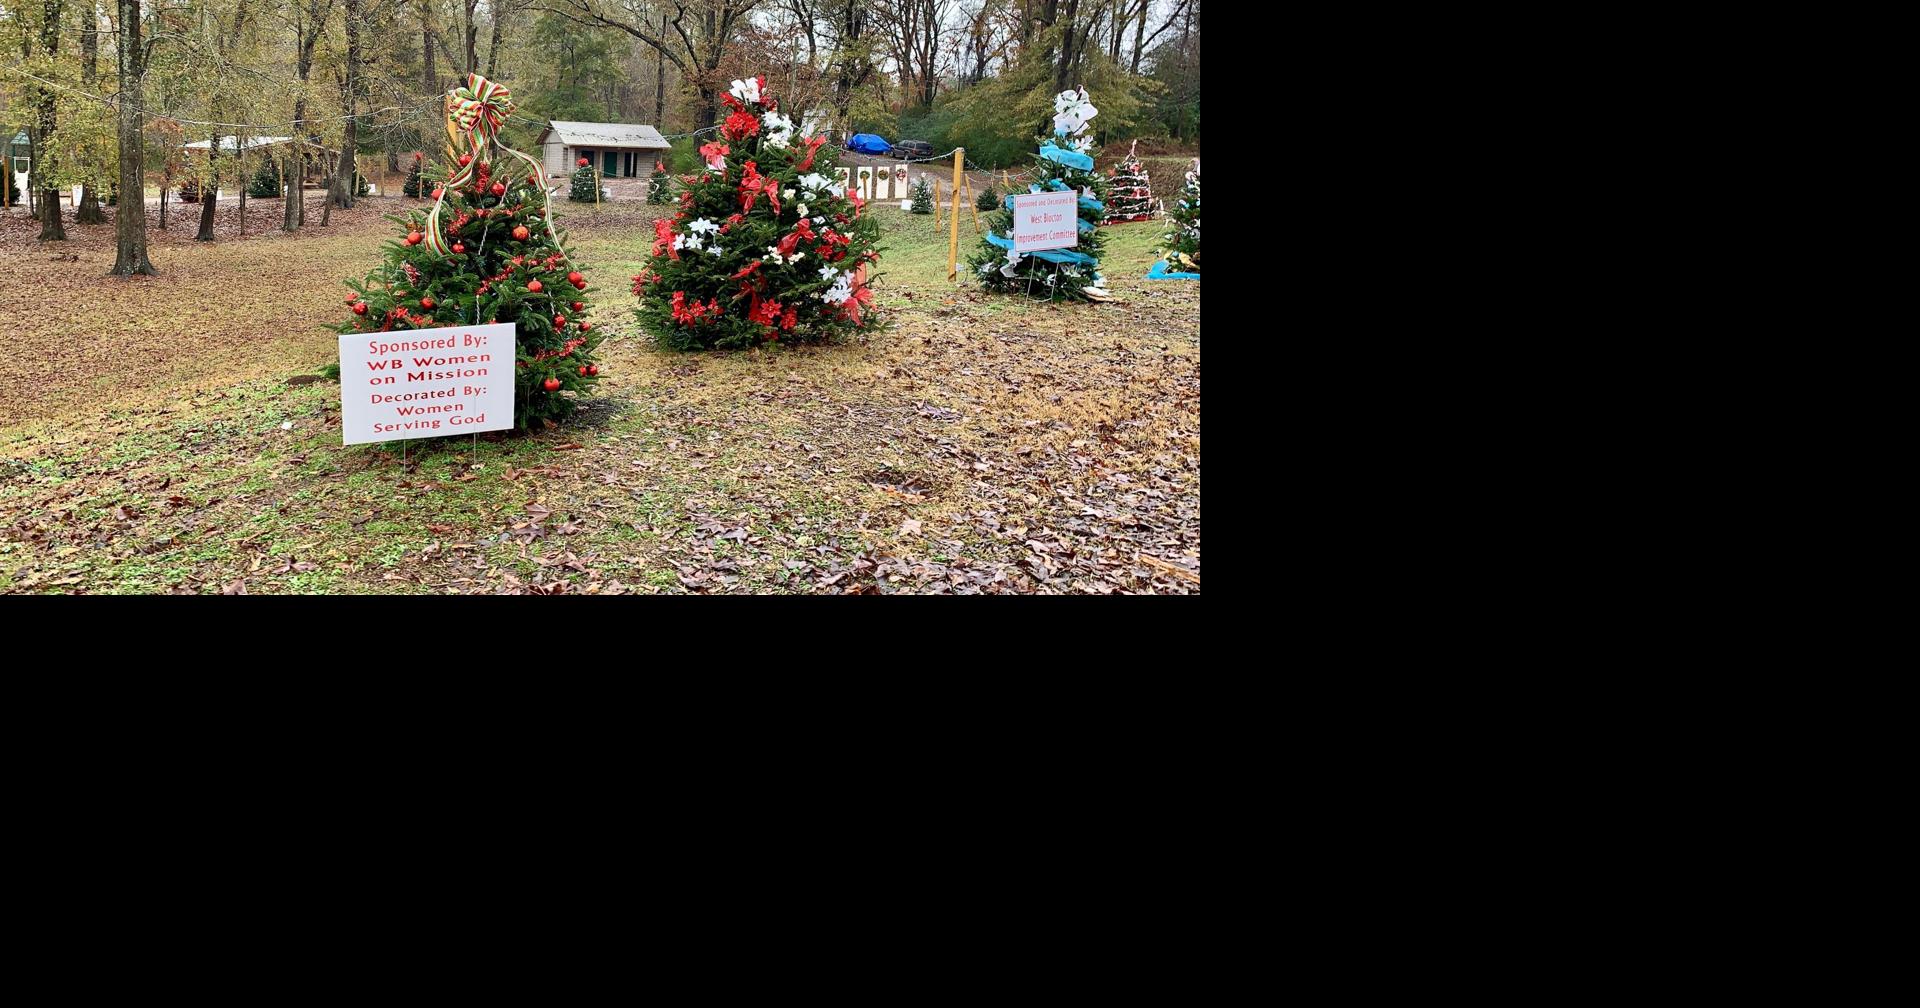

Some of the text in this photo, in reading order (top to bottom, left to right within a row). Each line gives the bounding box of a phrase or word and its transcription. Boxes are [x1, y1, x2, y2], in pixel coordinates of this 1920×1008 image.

[1017, 200, 1037, 208] Sponsored
[1030, 214, 1042, 223] West
[1016, 229, 1076, 244] Improvement Committee
[369, 334, 487, 356] Sponsored By:
[367, 354, 491, 371] WB Women
[369, 368, 488, 386] on Mission
[371, 386, 487, 404] Decorated By:
[396, 403, 464, 417] Women
[374, 413, 485, 433] Serving God
